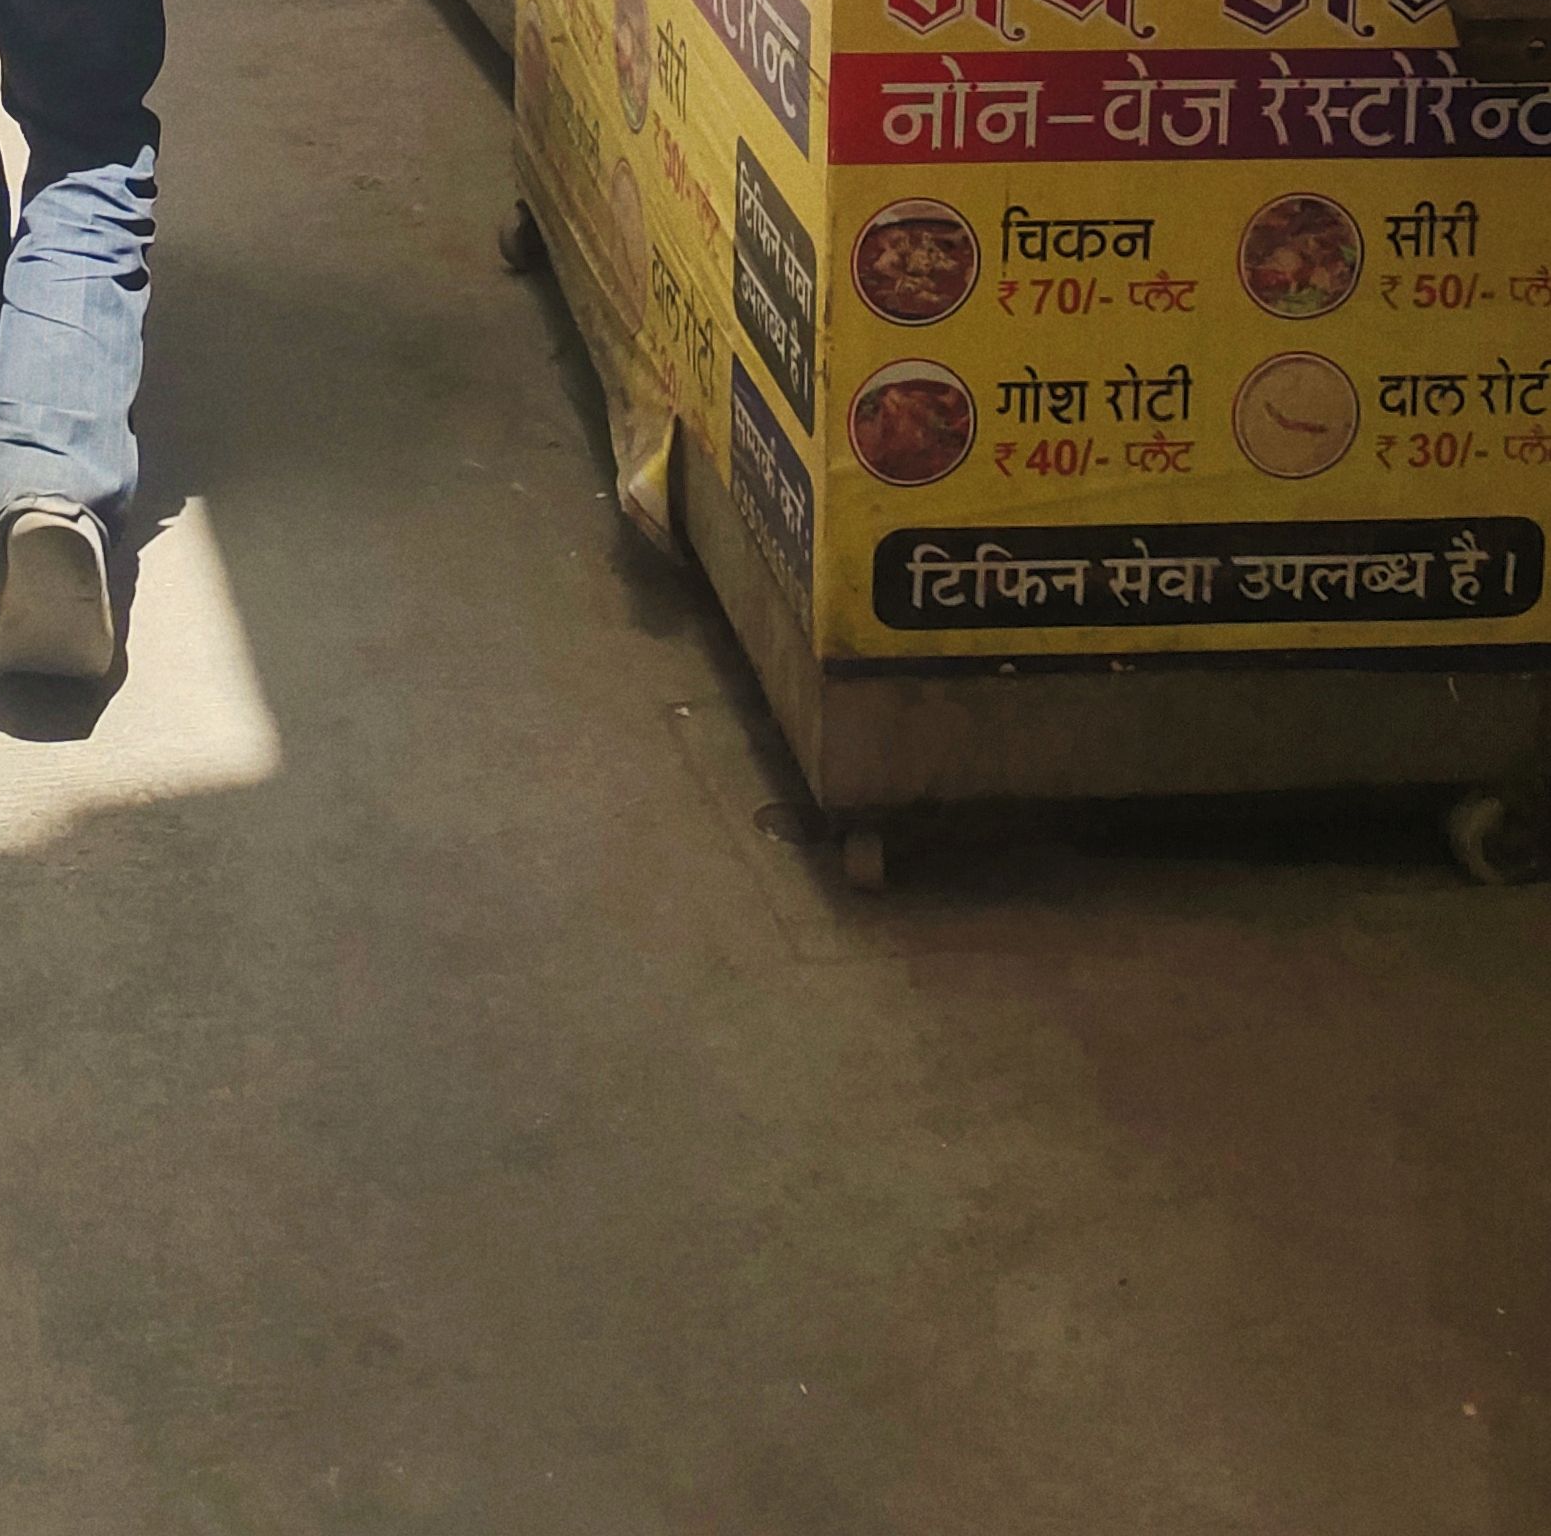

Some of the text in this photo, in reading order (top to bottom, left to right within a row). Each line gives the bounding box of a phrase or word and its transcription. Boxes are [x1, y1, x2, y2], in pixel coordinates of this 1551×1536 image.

[1001, 205, 1155, 262] चिकन
[1384, 201, 1479, 257] सीरी
[996, 363, 1192, 424] गोश रोटी
[1378, 375, 1467, 417] दाल
[905, 543, 1091, 609] टिफिन
[1102, 538, 1221, 606] सेवा
[1231, 552, 1435, 601] उपलब्ध
